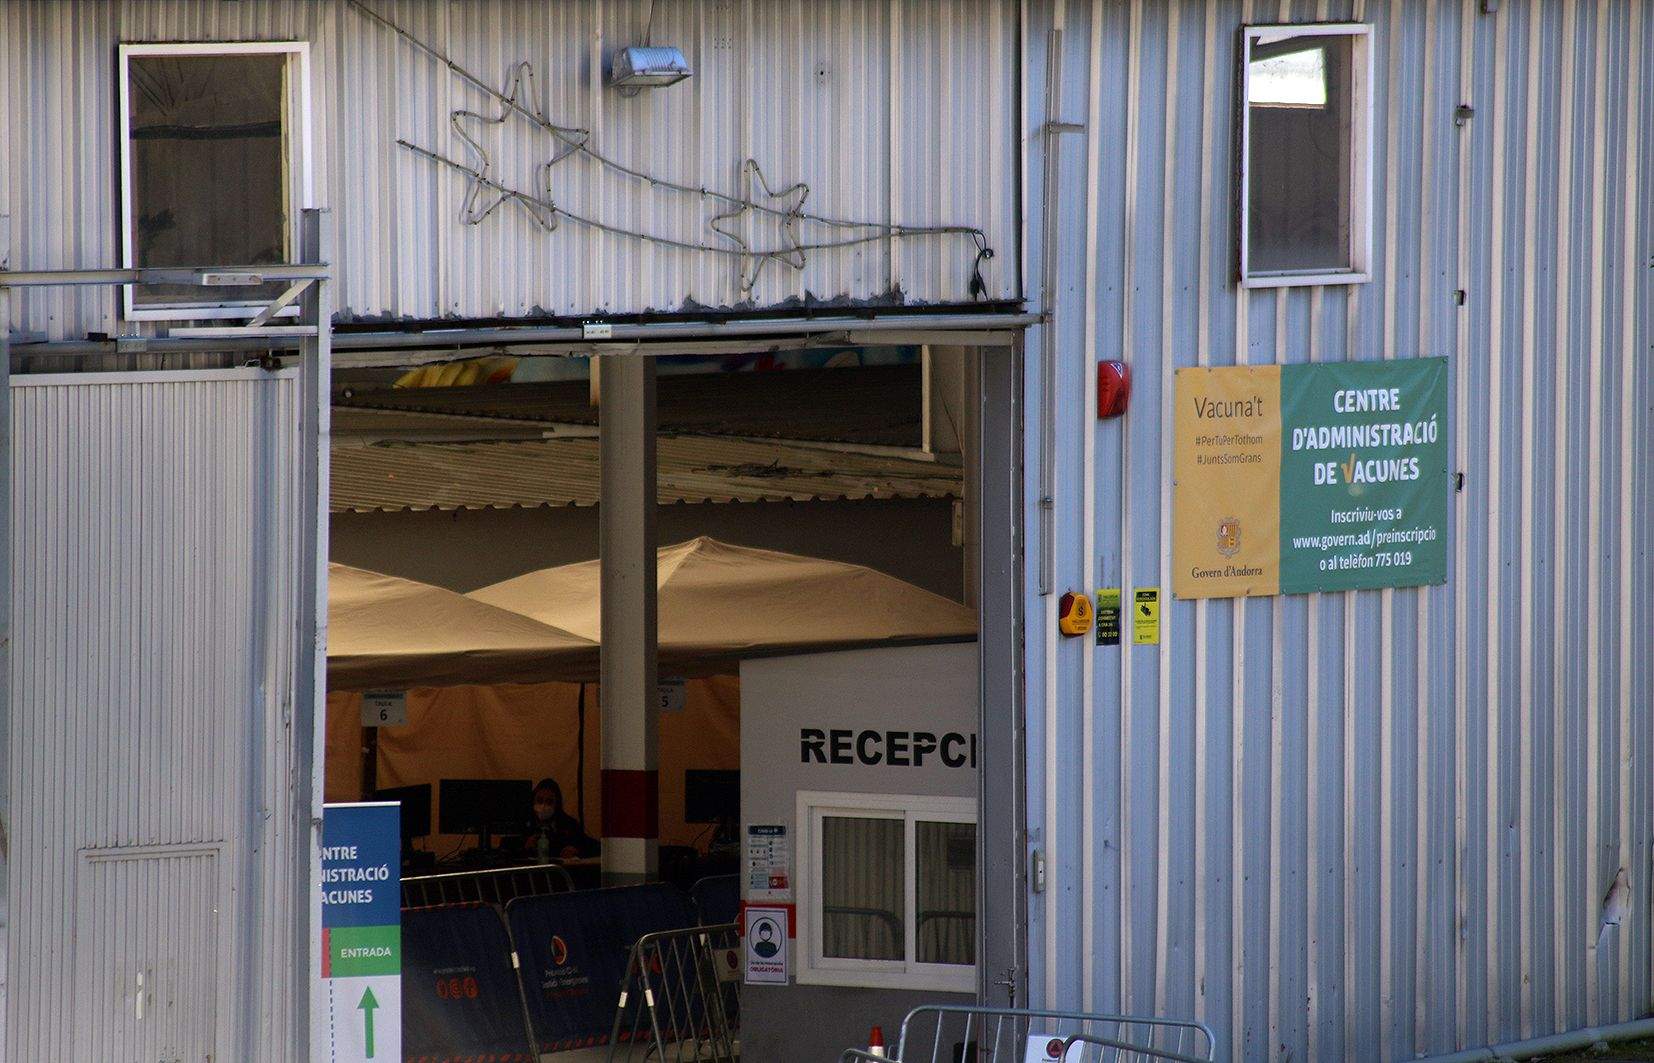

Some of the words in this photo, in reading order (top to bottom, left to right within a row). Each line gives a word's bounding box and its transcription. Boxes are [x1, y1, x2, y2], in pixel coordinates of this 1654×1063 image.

[1194, 396, 1263, 418] Vacuna't
[1333, 388, 1400, 413] CENTRE
[1292, 413, 1438, 451] D'ADMINISTRACIÓ
[1197, 453, 1262, 465] #JuntsSomGrans
[1314, 462, 1337, 485] DE
[1331, 507, 1394, 523] Inscriviu-vos
[1396, 508, 1402, 520] a
[1292, 526, 1436, 550] www.govern.ad/preinscripcio
[1319, 559, 1326, 571] o
[1328, 555, 1337, 570] al
[1339, 553, 1373, 569] telèfon
[1375, 552, 1391, 567] 775
[1393, 551, 1412, 566] 019
[1191, 567, 1222, 578] Govern
[1224, 564, 1263, 577] d'Andorra
[661, 695, 669, 707] 5
[380, 709, 388, 721] 6
[320, 846, 358, 860] NTRE
[341, 947, 392, 958] ENTRADA
